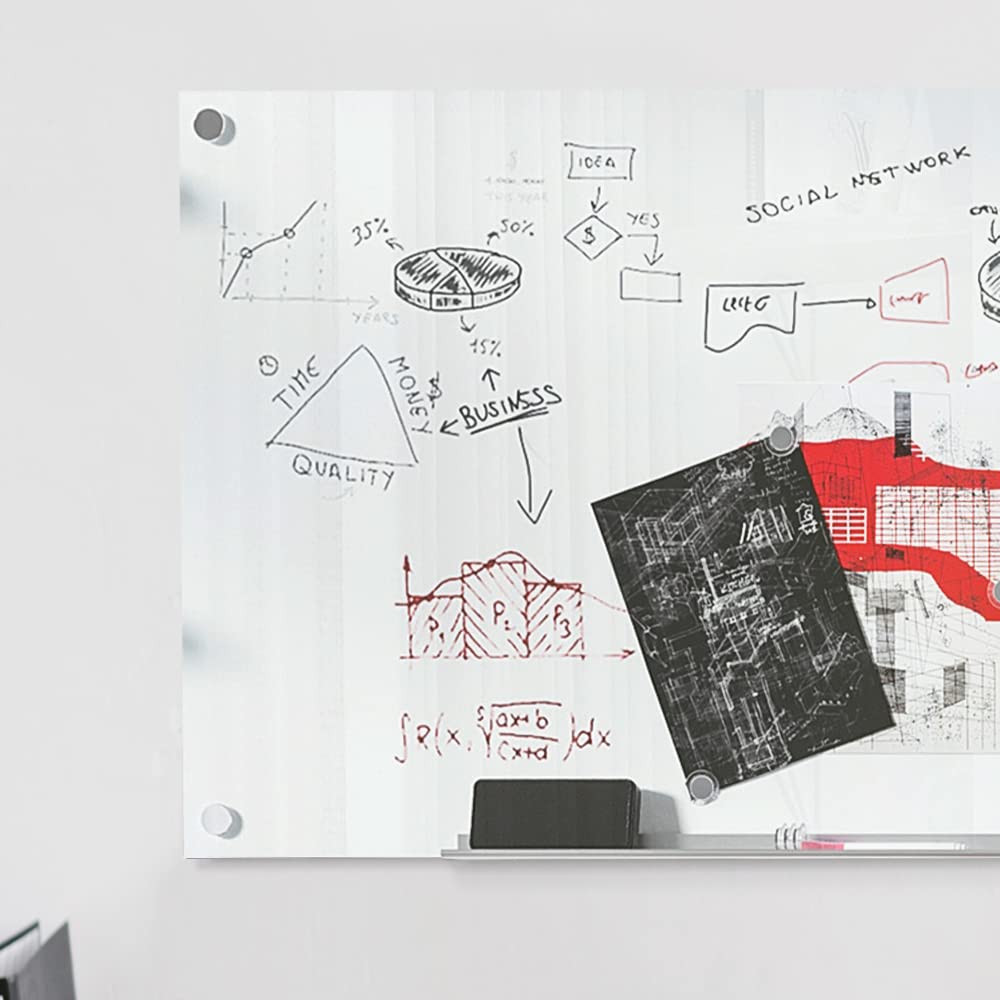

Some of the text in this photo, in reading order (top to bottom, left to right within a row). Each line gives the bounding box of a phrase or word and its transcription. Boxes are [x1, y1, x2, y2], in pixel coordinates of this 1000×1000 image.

[578, 155, 616, 170] IDEA
[745, 145, 972, 224] SOCIAL NETWORK
[352, 217, 390, 246] 35%
[500, 218, 535, 237] 50%
[626, 211, 661, 229] YES
[352, 311, 400, 326] YEARS
[469, 338, 502, 358] 15%
[271, 354, 321, 411] TIME
[387, 355, 434, 435] MONEY
[459, 384, 563, 431] BUSINESS
[291, 453, 396, 491] QUALITY
